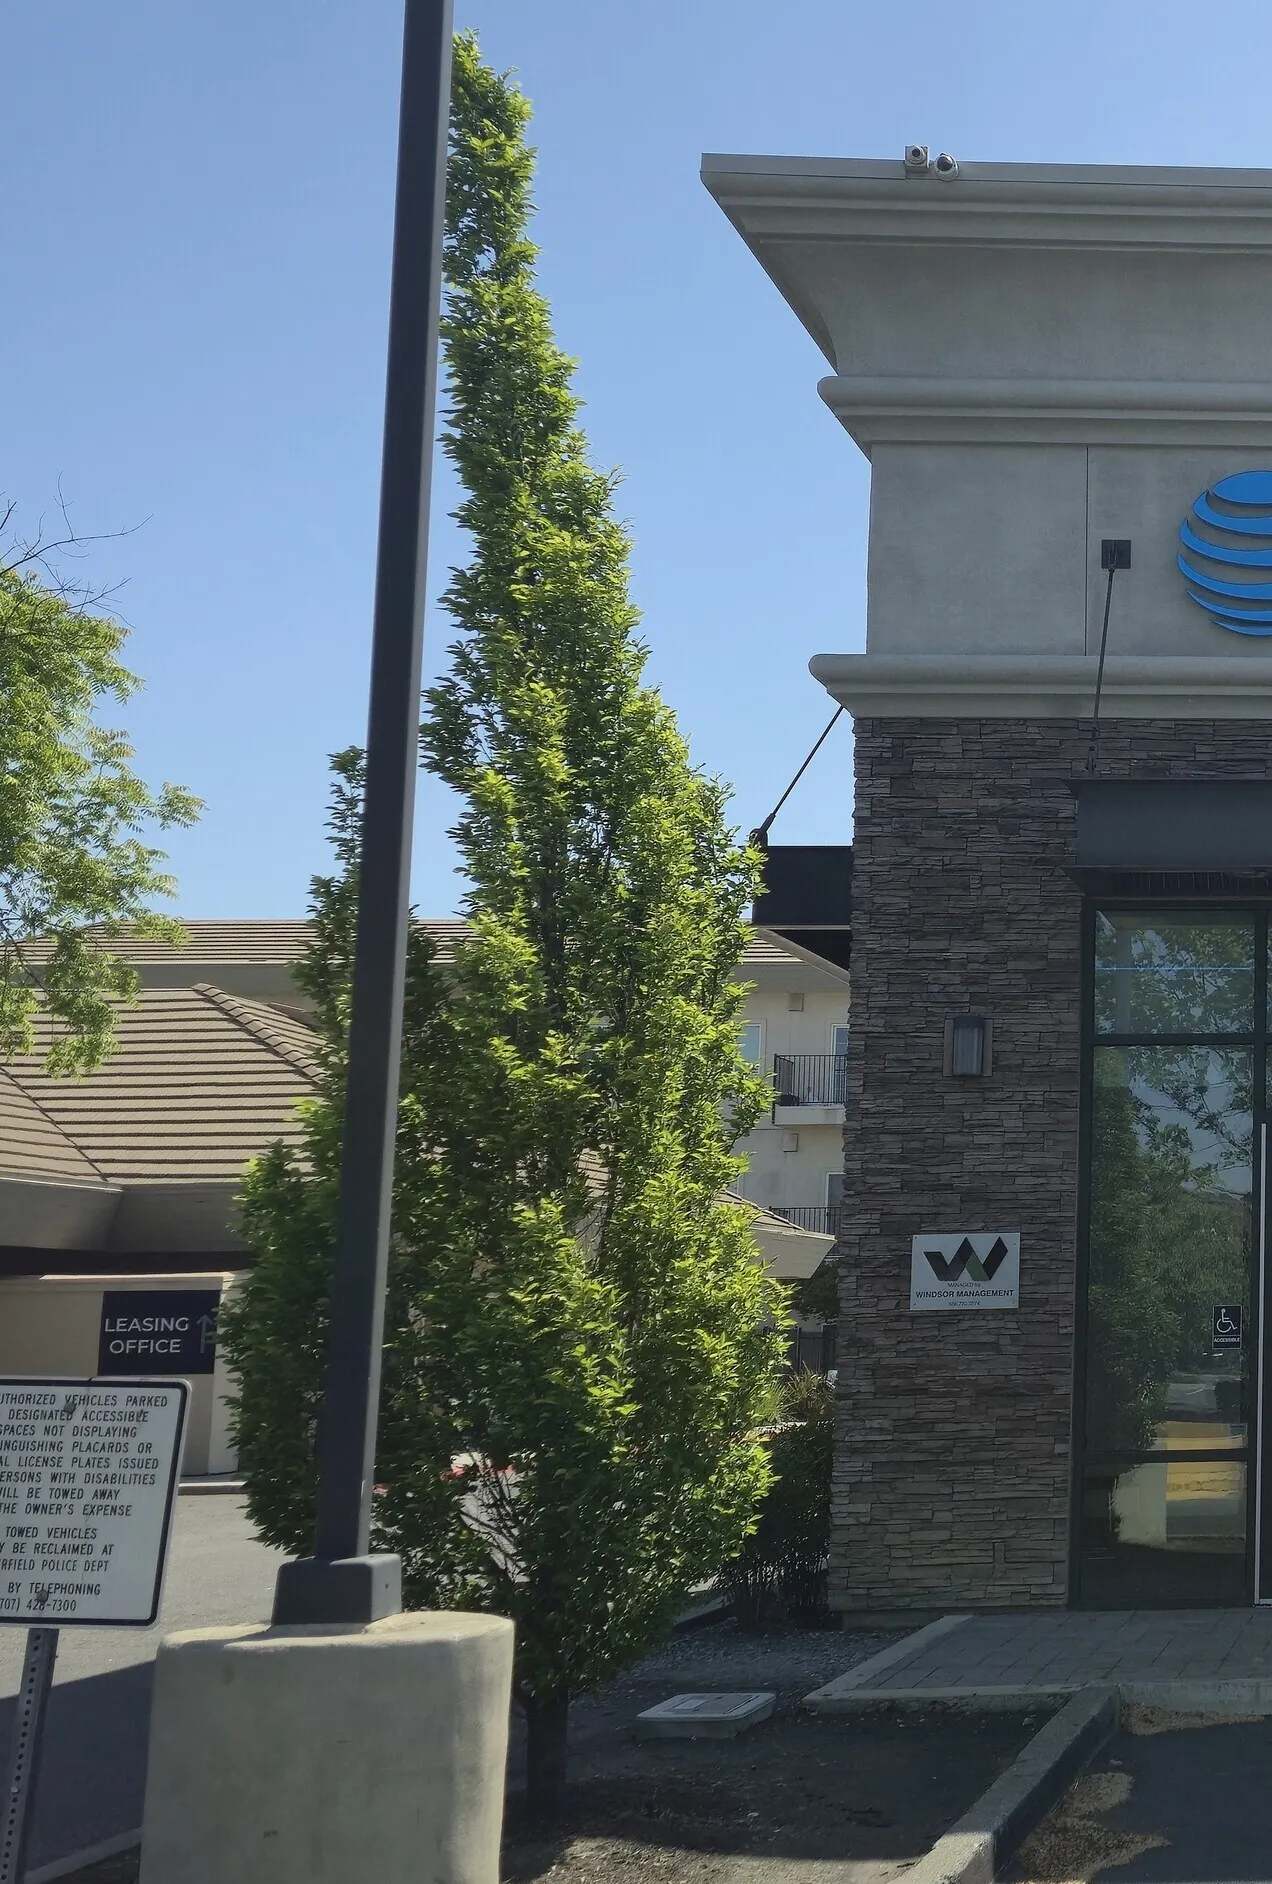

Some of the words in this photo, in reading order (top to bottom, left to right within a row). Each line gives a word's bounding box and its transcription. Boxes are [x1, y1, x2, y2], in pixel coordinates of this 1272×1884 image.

[957, 1289, 1014, 1297] MANAGEMENT
[105, 1317, 189, 1331] LEASING
[110, 1339, 181, 1353] OFFICE
[65, 1394, 117, 1407] VEHICLES
[125, 1395, 168, 1407] PARKED
[8, 1409, 73, 1421] DESIGNATED
[81, 1410, 149, 1422] ACCESSIBLE
[43, 1425, 65, 1436] NOT
[72, 1425, 138, 1438] DISPLAYING
[0, 1440, 64, 1452] INGUISHING
[72, 1441, 129, 1453] PLACARDS
[137, 1442, 153, 1454] OR
[18, 1456, 64, 1468] LICENSE
[71, 1457, 110, 1469] PLATES
[118, 1458, 159, 1470] ISSUED
[50, 1472, 76, 1484] WITH
[84, 1473, 156, 1485] DISABILITIES
[27, 1487, 42, 1499] BE
[49, 1488, 84, 1500] TOWED
[92, 1489, 121, 1500] AWAY
[25, 1503, 74, 1515] OWNER'S
[82, 1504, 132, 1516] EXPENSE
[6, 1526, 38, 1538] TOWED
[47, 1527, 98, 1539] VEHICLES
[12, 1542, 27, 1554] BE
[33, 1543, 94, 1555] RECLAIMED
[101, 1544, 113, 1555] AT
[0, 1558, 35, 1570] RFIELD
[41, 1559, 78, 1571] POLICE
[84, 1560, 110, 1572] DEPT
[8, 1581, 22, 1594] BY
[29, 1582, 101, 1595] TELEPHONING
[26, 1598, 77, 1611] 428-7300
